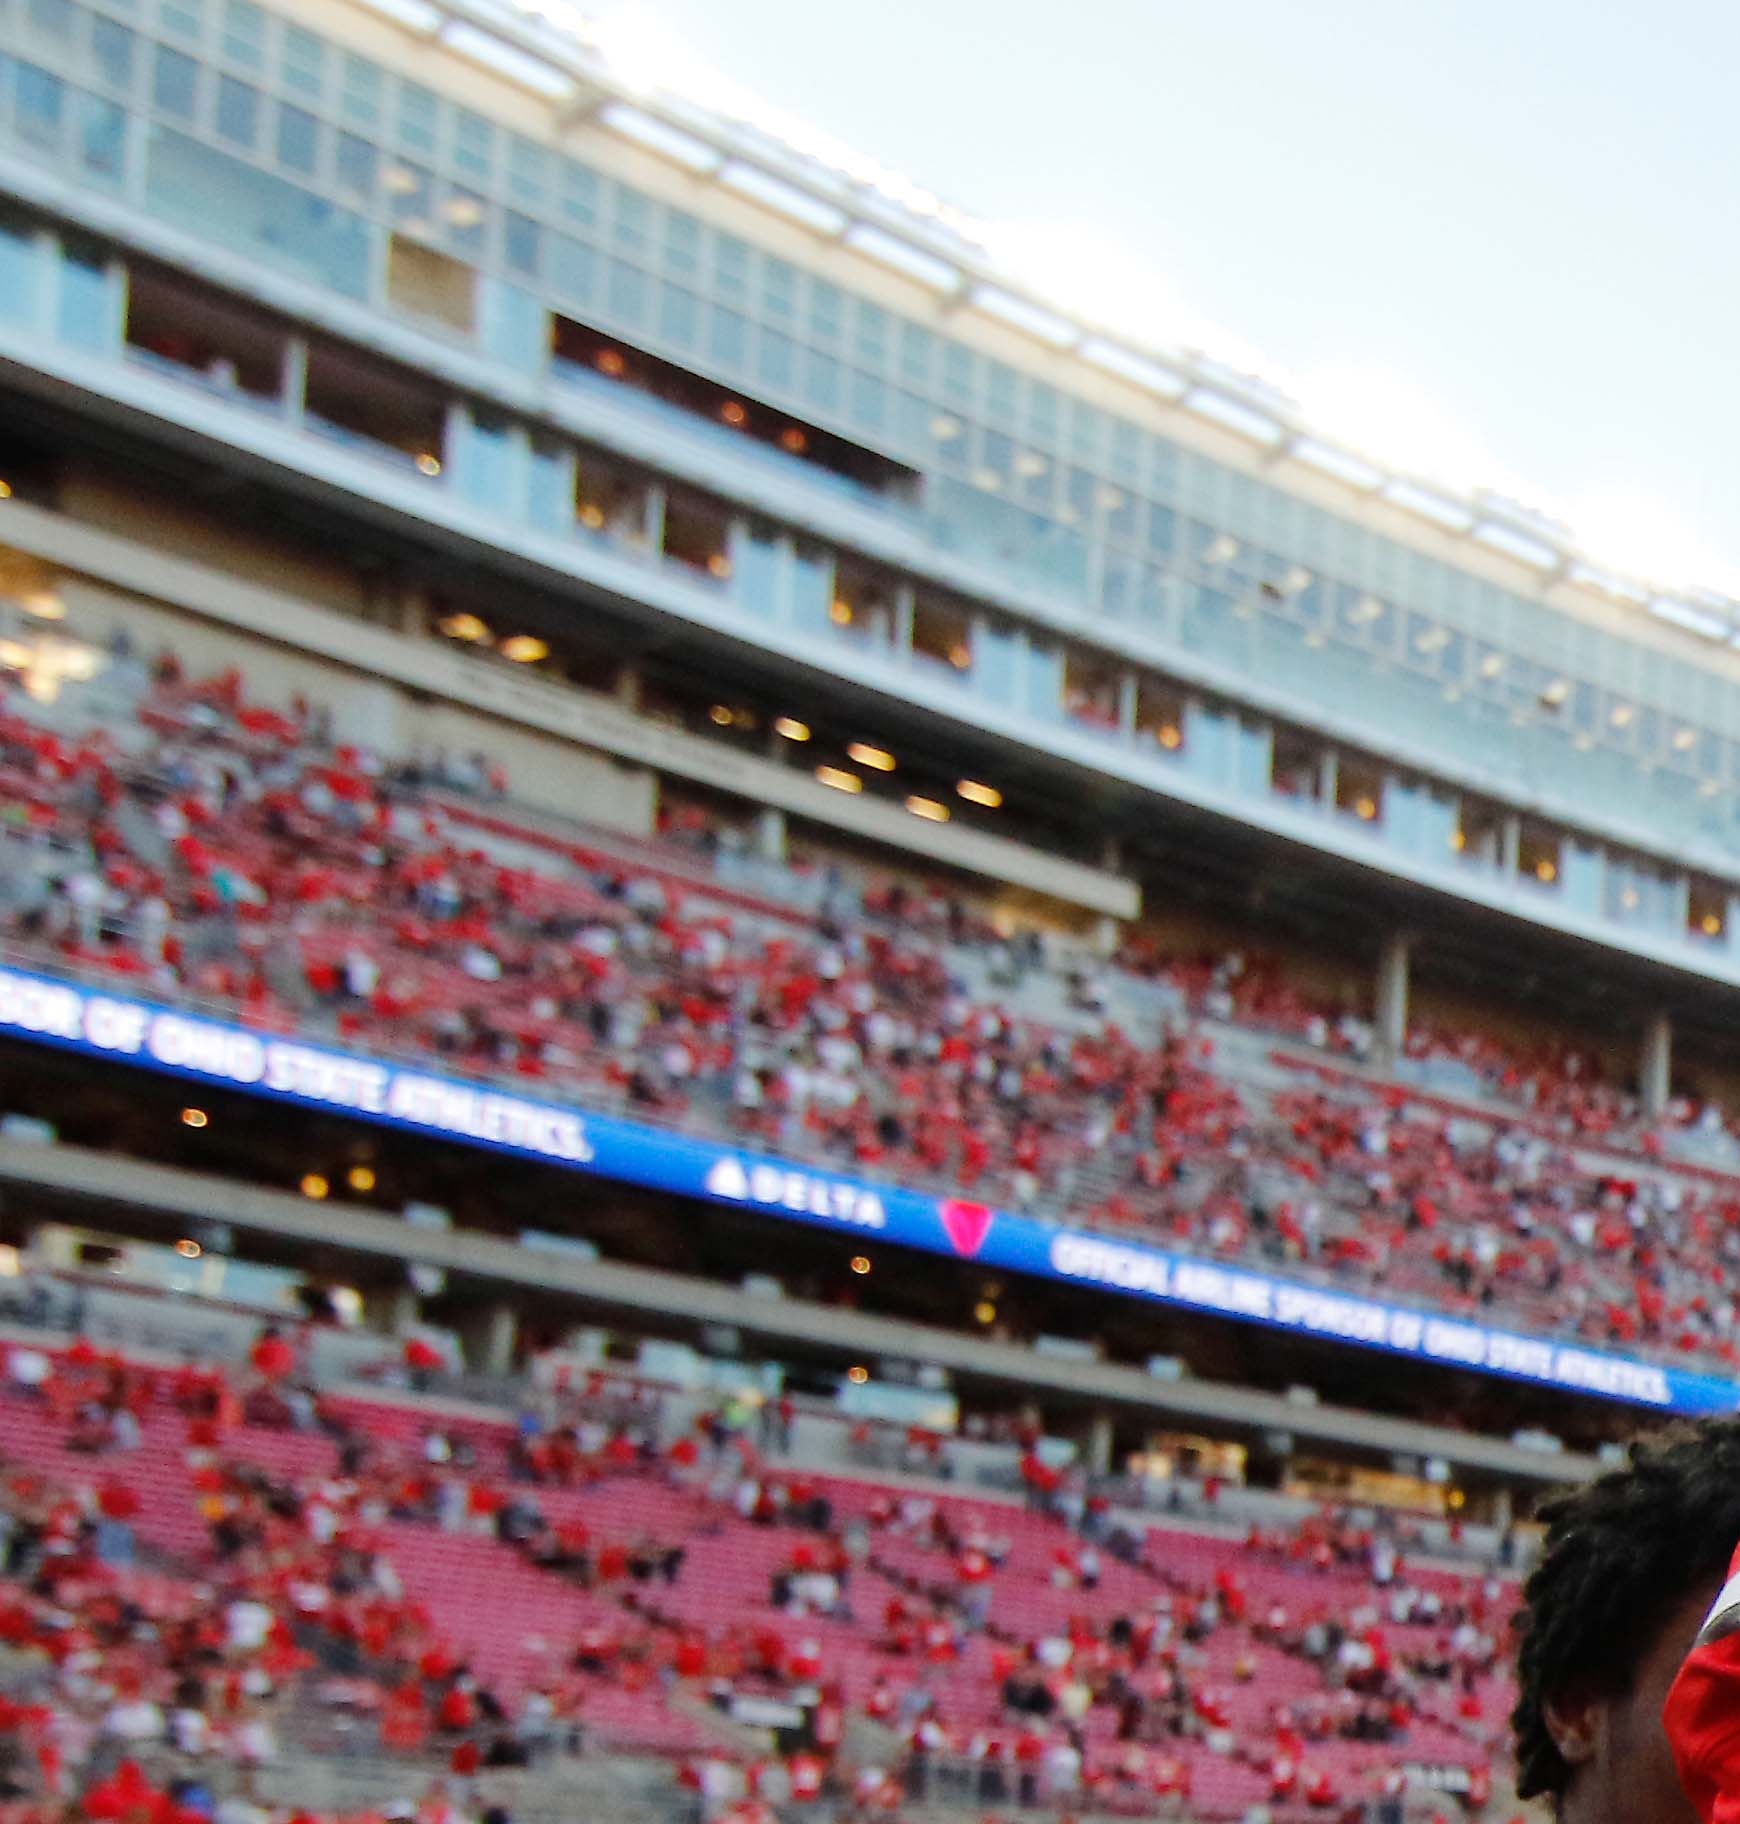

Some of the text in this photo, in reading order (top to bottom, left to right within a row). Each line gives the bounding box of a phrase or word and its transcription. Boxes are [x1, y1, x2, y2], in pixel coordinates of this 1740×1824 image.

[84, 996, 146, 1054] OF
[151, 1012, 266, 1084] OHIO
[265, 1041, 389, 1116] STATE
[751, 1163, 887, 1230] DELTA
[1053, 1233, 1170, 1297] OFFICIAL
[1275, 1282, 1386, 1345] SPONSOR
[1487, 1331, 1552, 1380] STATE
